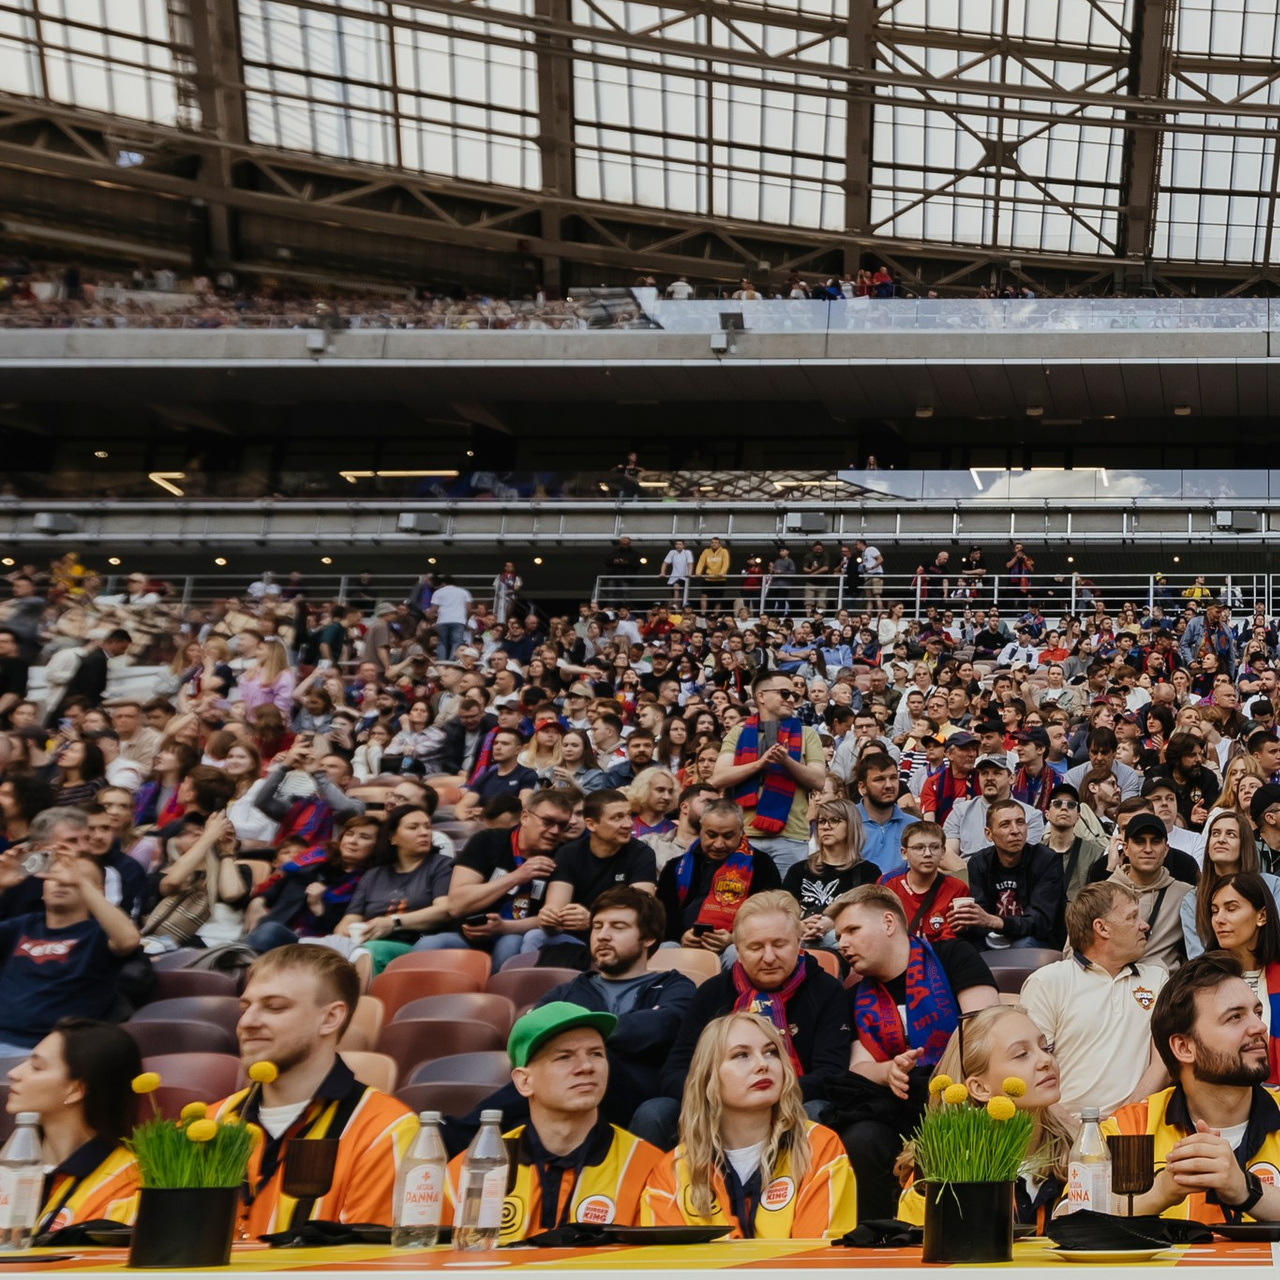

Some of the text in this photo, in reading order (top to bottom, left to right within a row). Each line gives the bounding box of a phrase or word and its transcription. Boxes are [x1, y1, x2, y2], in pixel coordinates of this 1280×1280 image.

[405, 1191, 439, 1203] PANNA
[766, 1191, 787, 1201] KING
[583, 1211, 607, 1222] KING
